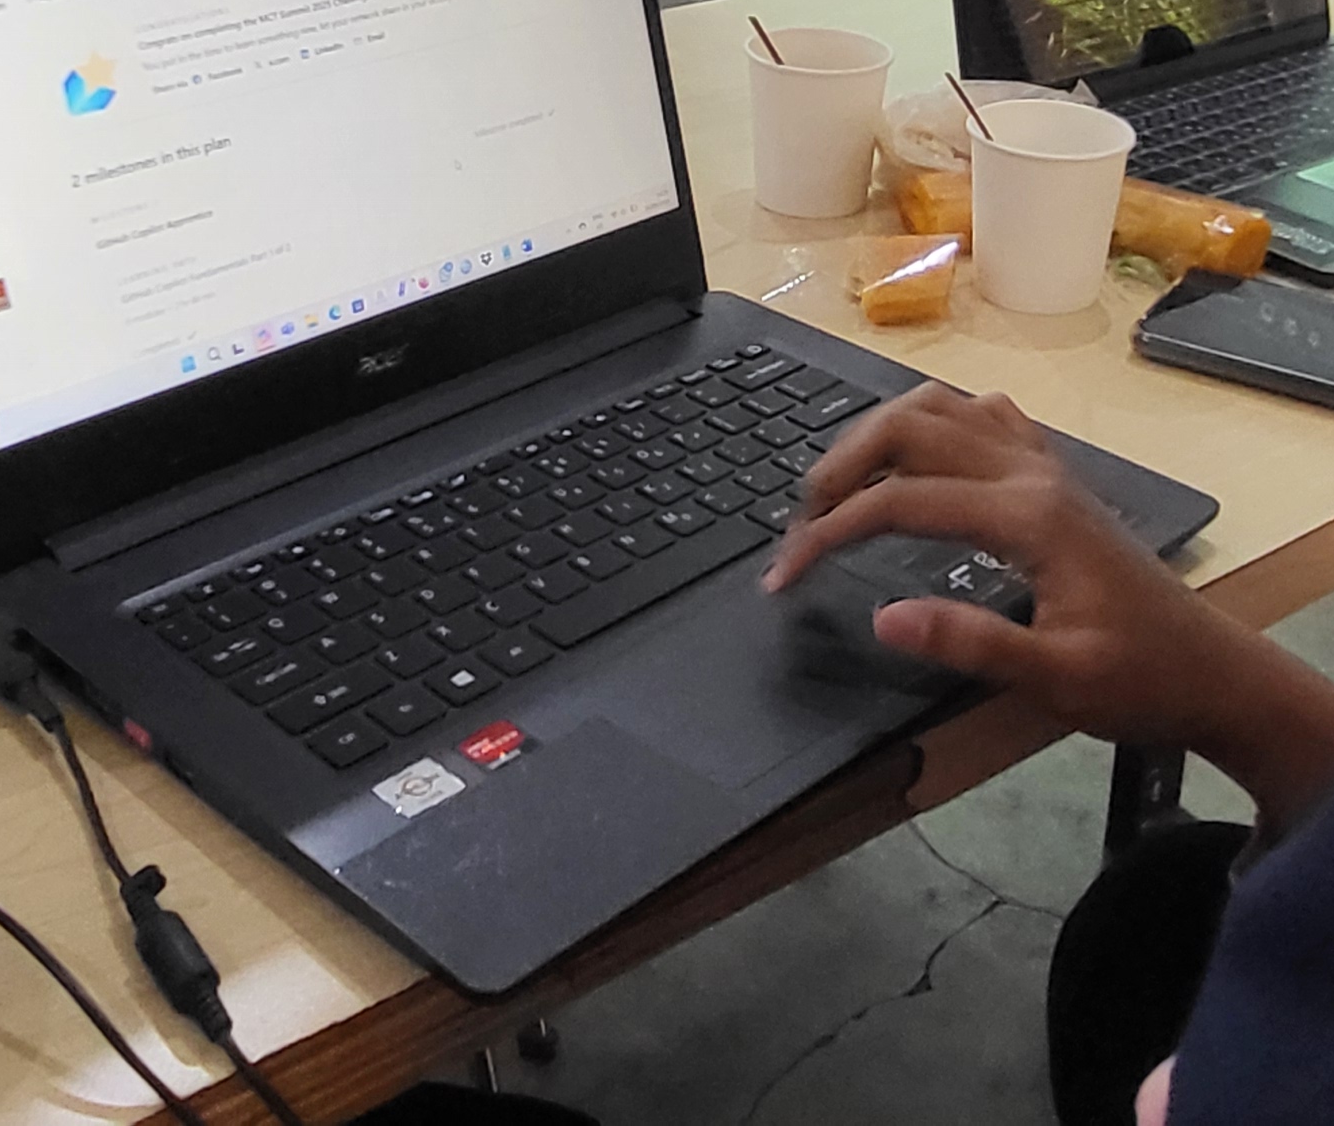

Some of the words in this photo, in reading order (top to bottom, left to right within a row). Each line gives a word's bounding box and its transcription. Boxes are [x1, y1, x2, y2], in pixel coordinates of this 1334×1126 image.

[71, 174, 81, 189] 2
[84, 157, 159, 184] milestones
[160, 153, 174, 164] in
[175, 146, 202, 160] this
[203, 138, 232, 157] plan
